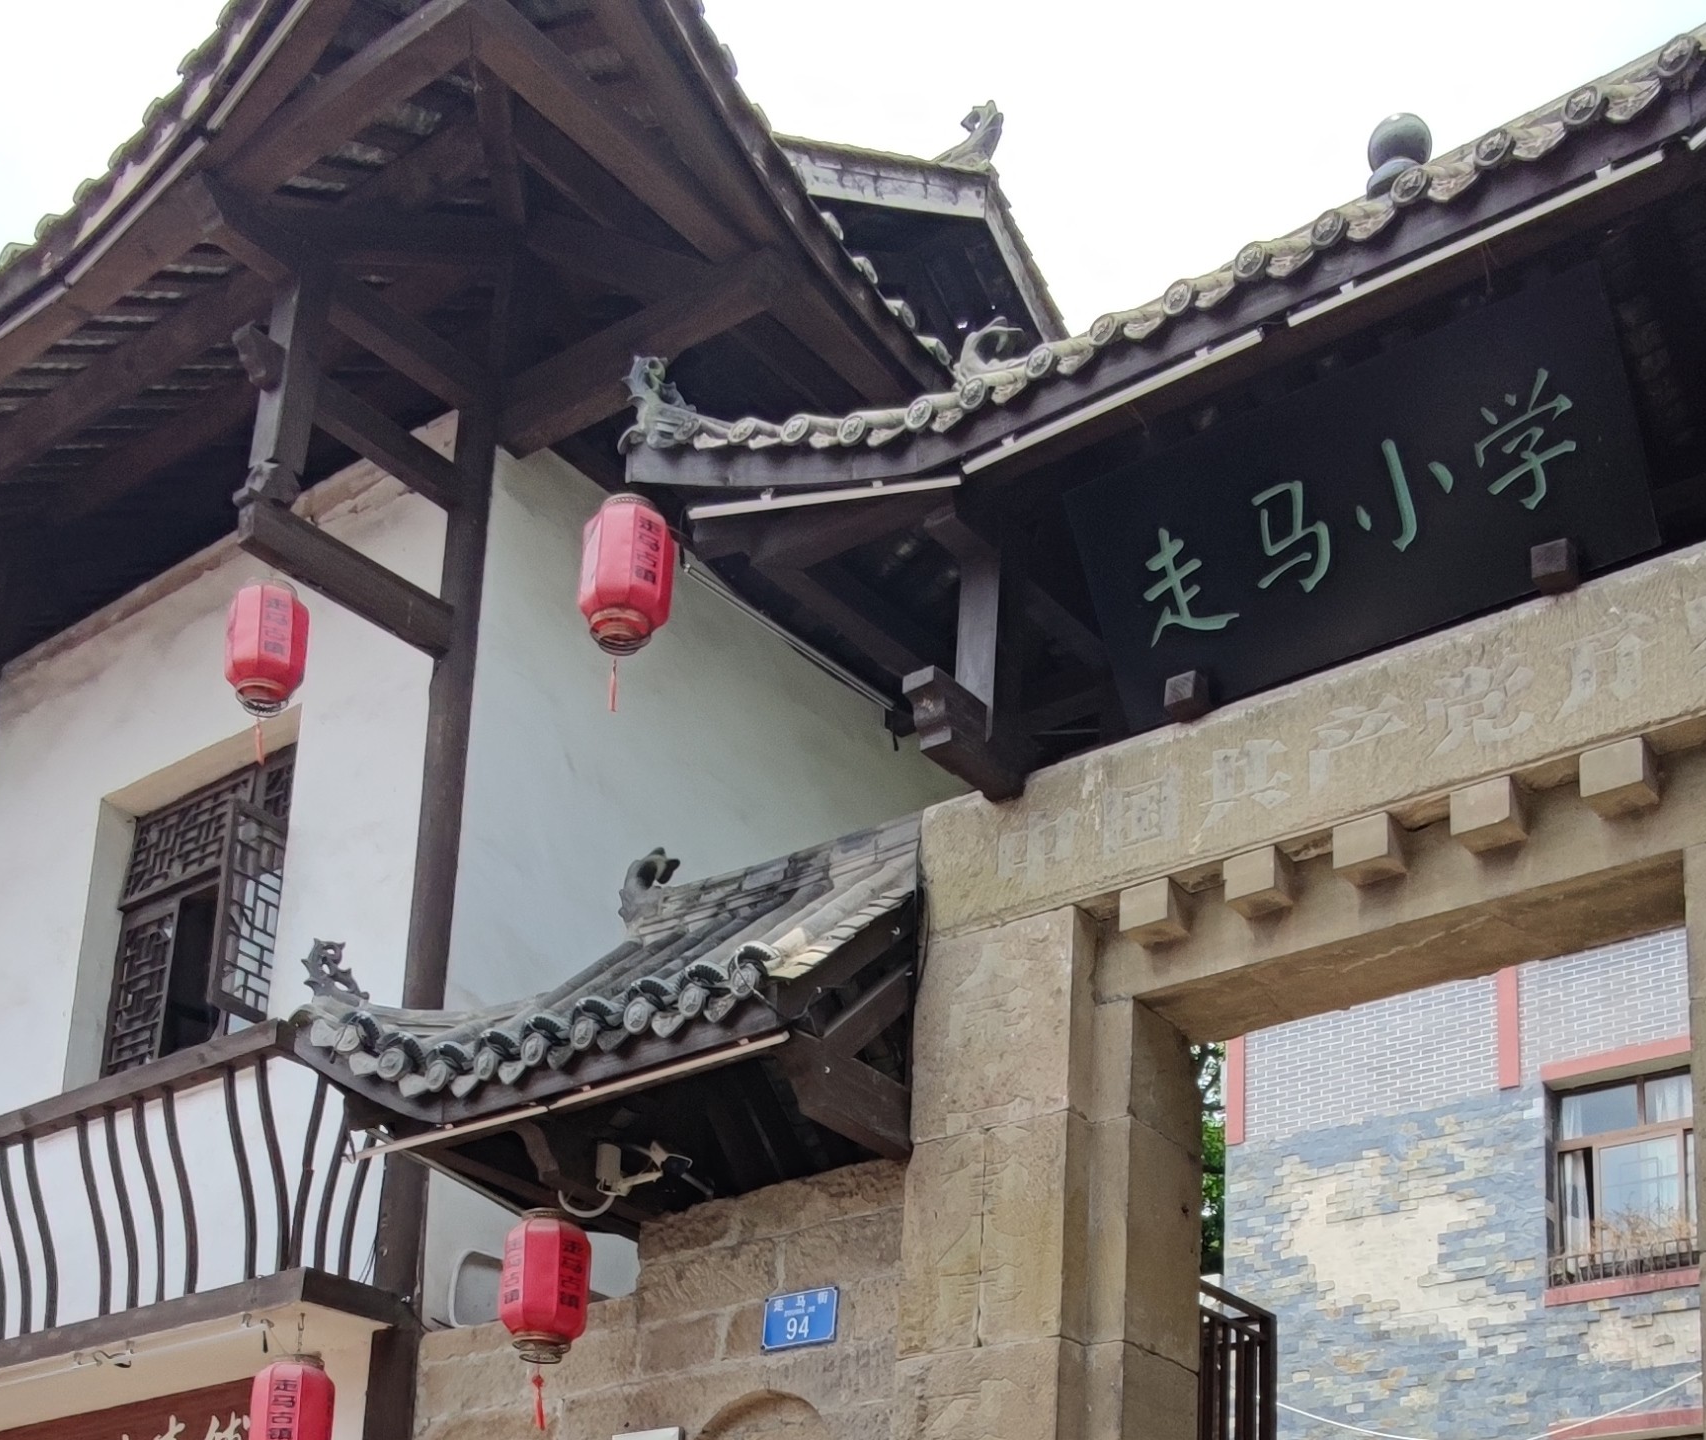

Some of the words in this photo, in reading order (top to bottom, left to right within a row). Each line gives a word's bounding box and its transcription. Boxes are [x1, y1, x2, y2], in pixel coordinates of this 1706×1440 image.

[1142, 367, 1577, 648] 走马小学
[559, 1239, 584, 1310] 走马古镇
[773, 1291, 829, 1313] 走马街
[786, 1315, 810, 1341] 94
